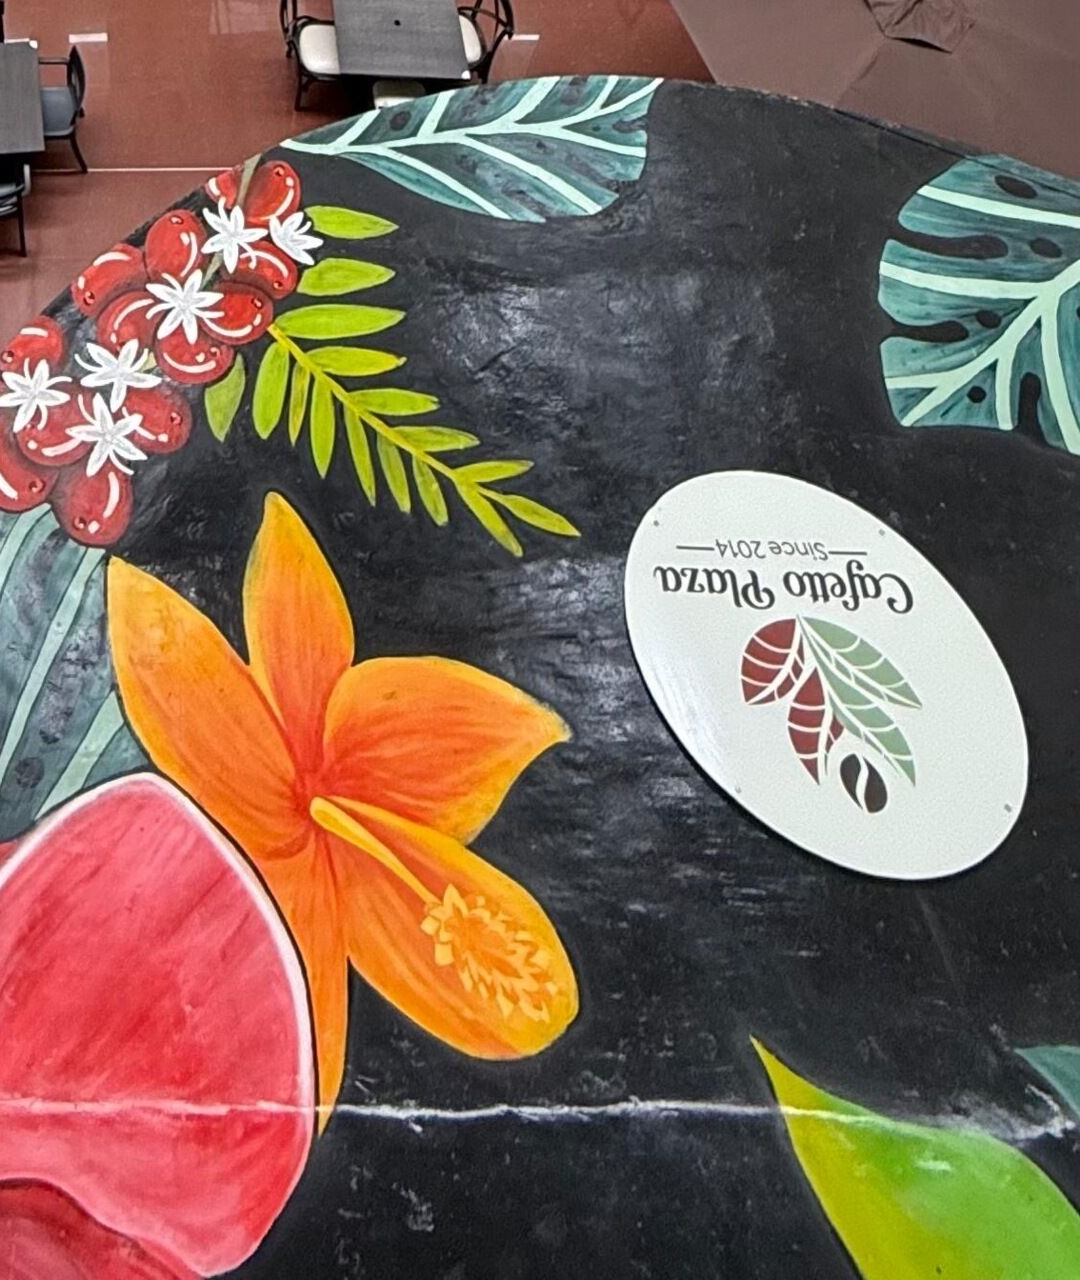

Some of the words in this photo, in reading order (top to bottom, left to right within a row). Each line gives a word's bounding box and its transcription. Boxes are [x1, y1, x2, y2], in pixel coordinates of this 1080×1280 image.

[716, 538, 766, 559] 2014
[770, 540, 829, 561] Since
[653, 566, 775, 610] Plaza
[783, 559, 913, 614] Cafetto
